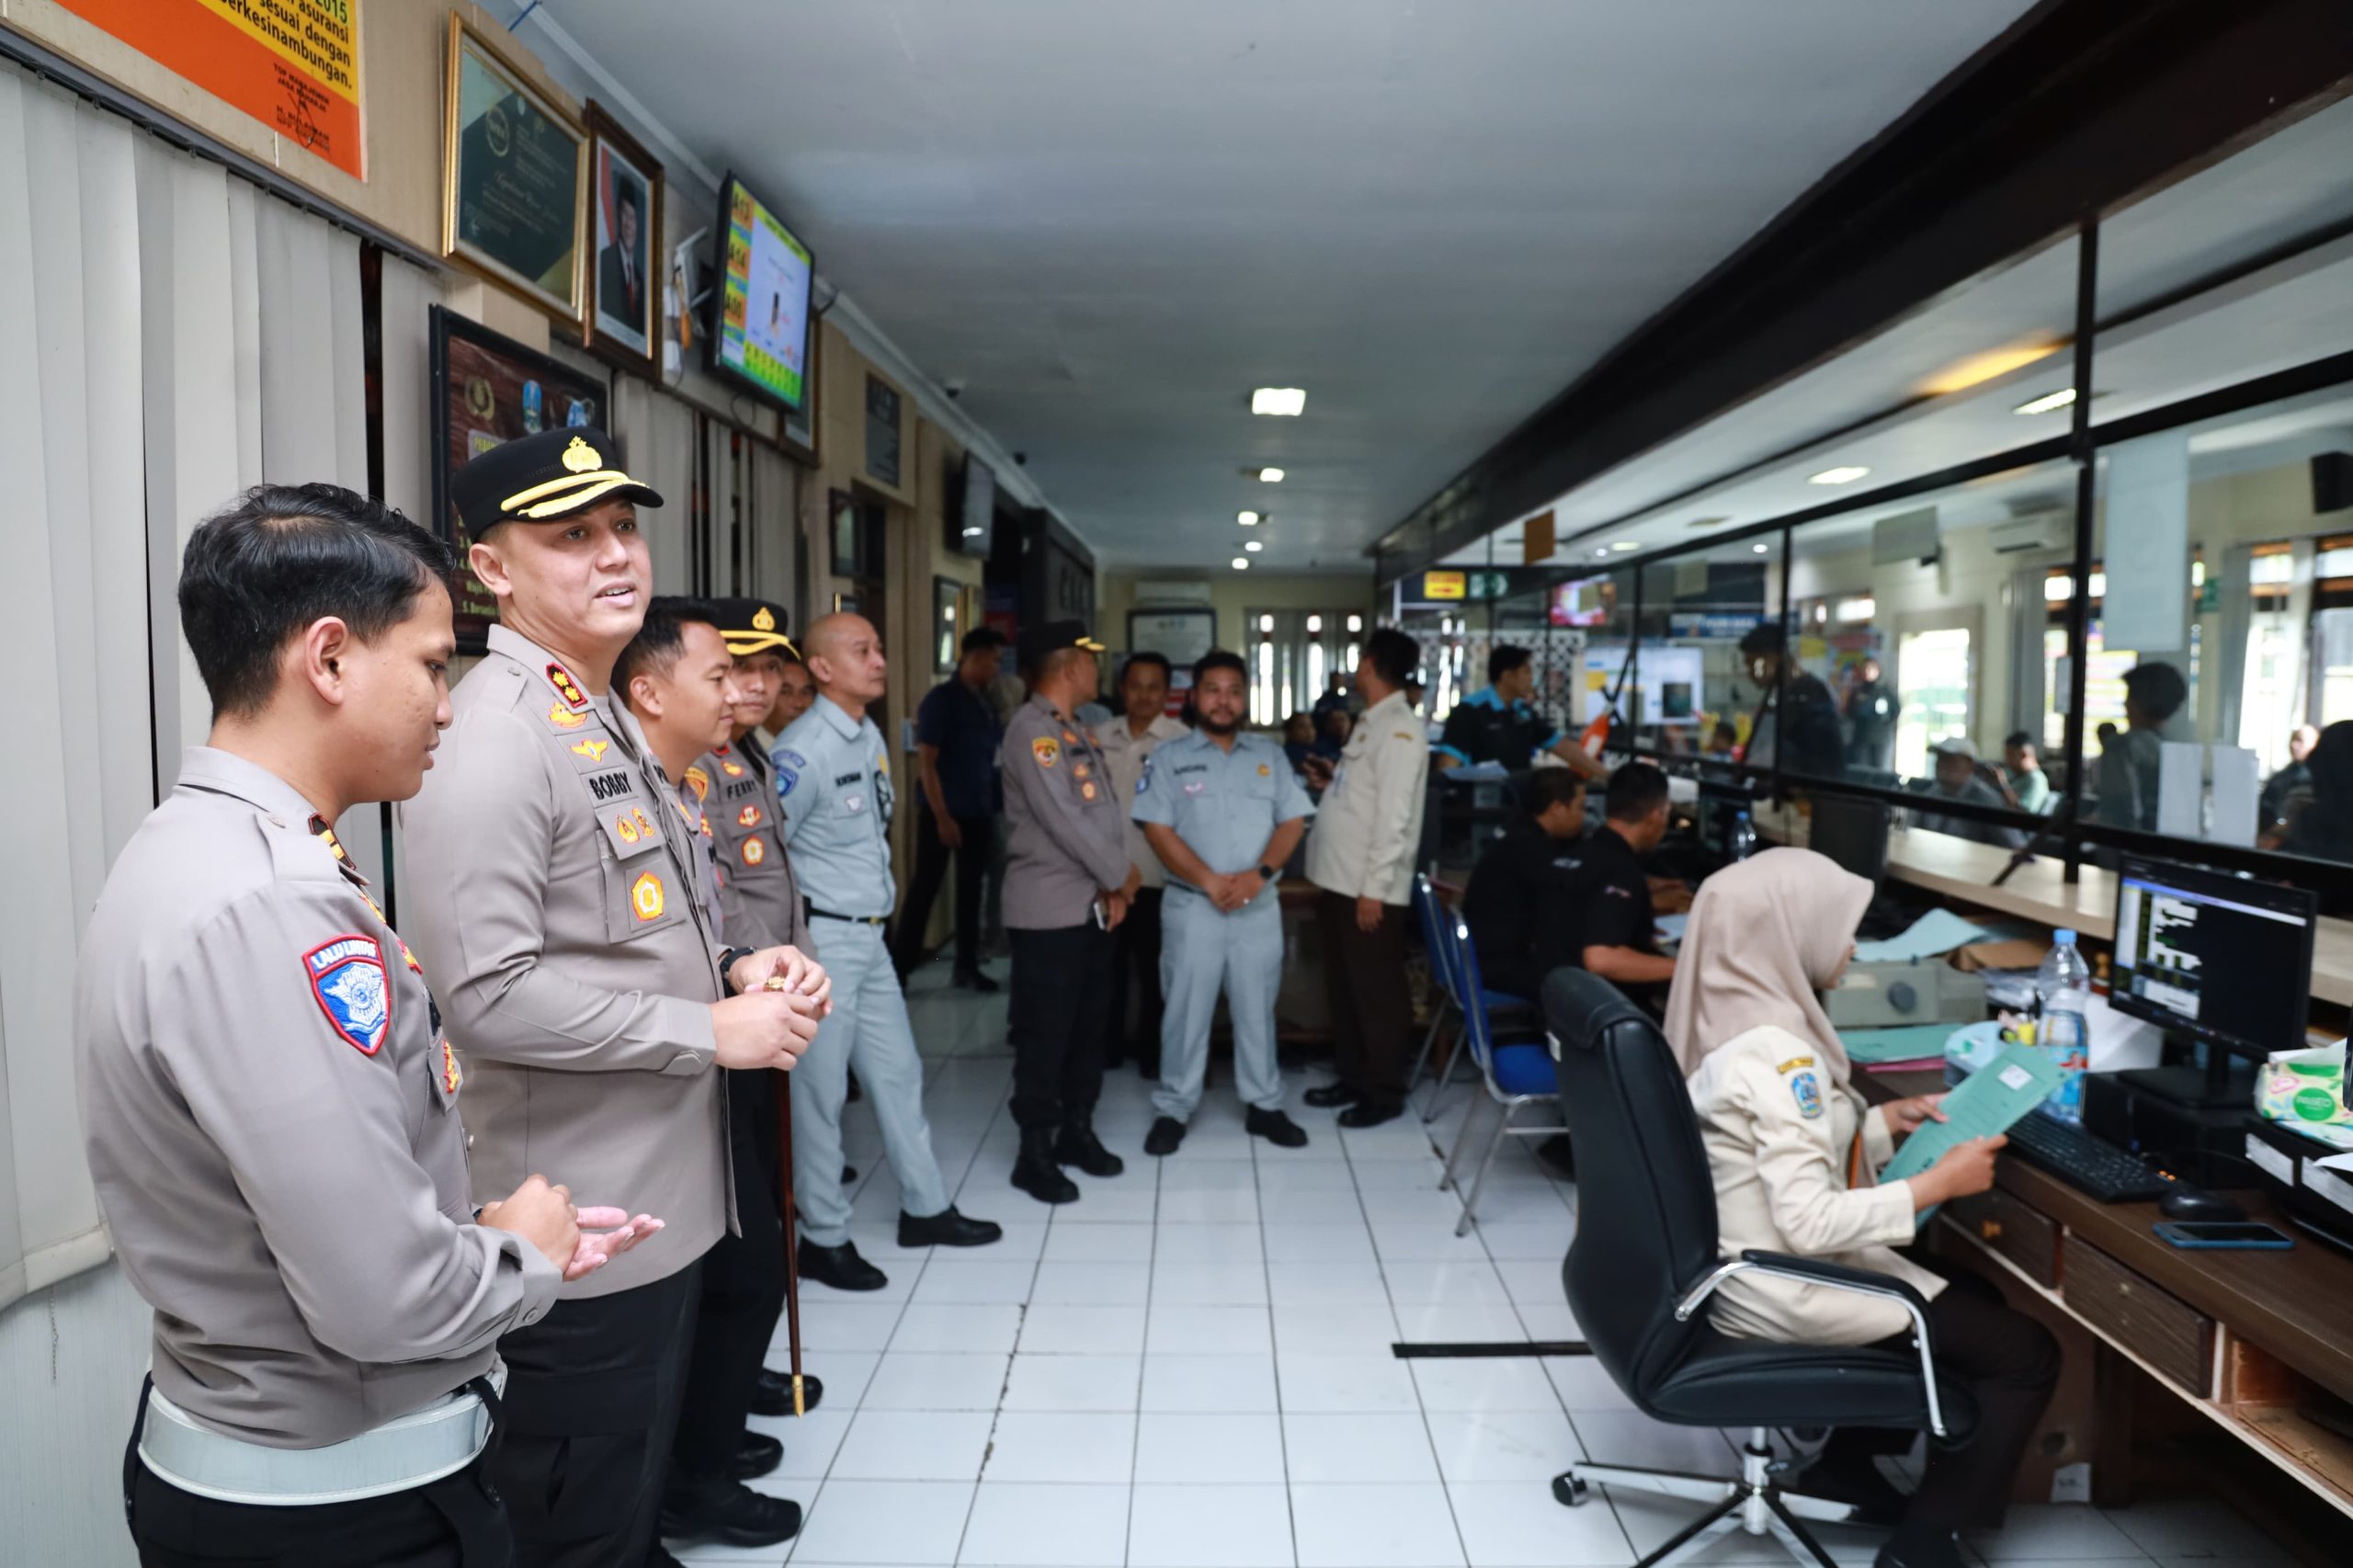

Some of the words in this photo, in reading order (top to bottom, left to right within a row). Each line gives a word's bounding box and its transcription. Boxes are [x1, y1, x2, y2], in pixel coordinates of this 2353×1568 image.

[299, 0, 349, 44] asuransi
[315, 0, 348, 24] 015
[220, 0, 352, 90] erkesinambungan.
[259, 0, 301, 31] sesuai
[304, 23, 351, 67] dengan
[589, 772, 632, 800] BOBBY
[310, 942, 345, 970] LALU
[343, 939, 377, 958] LINTAS
